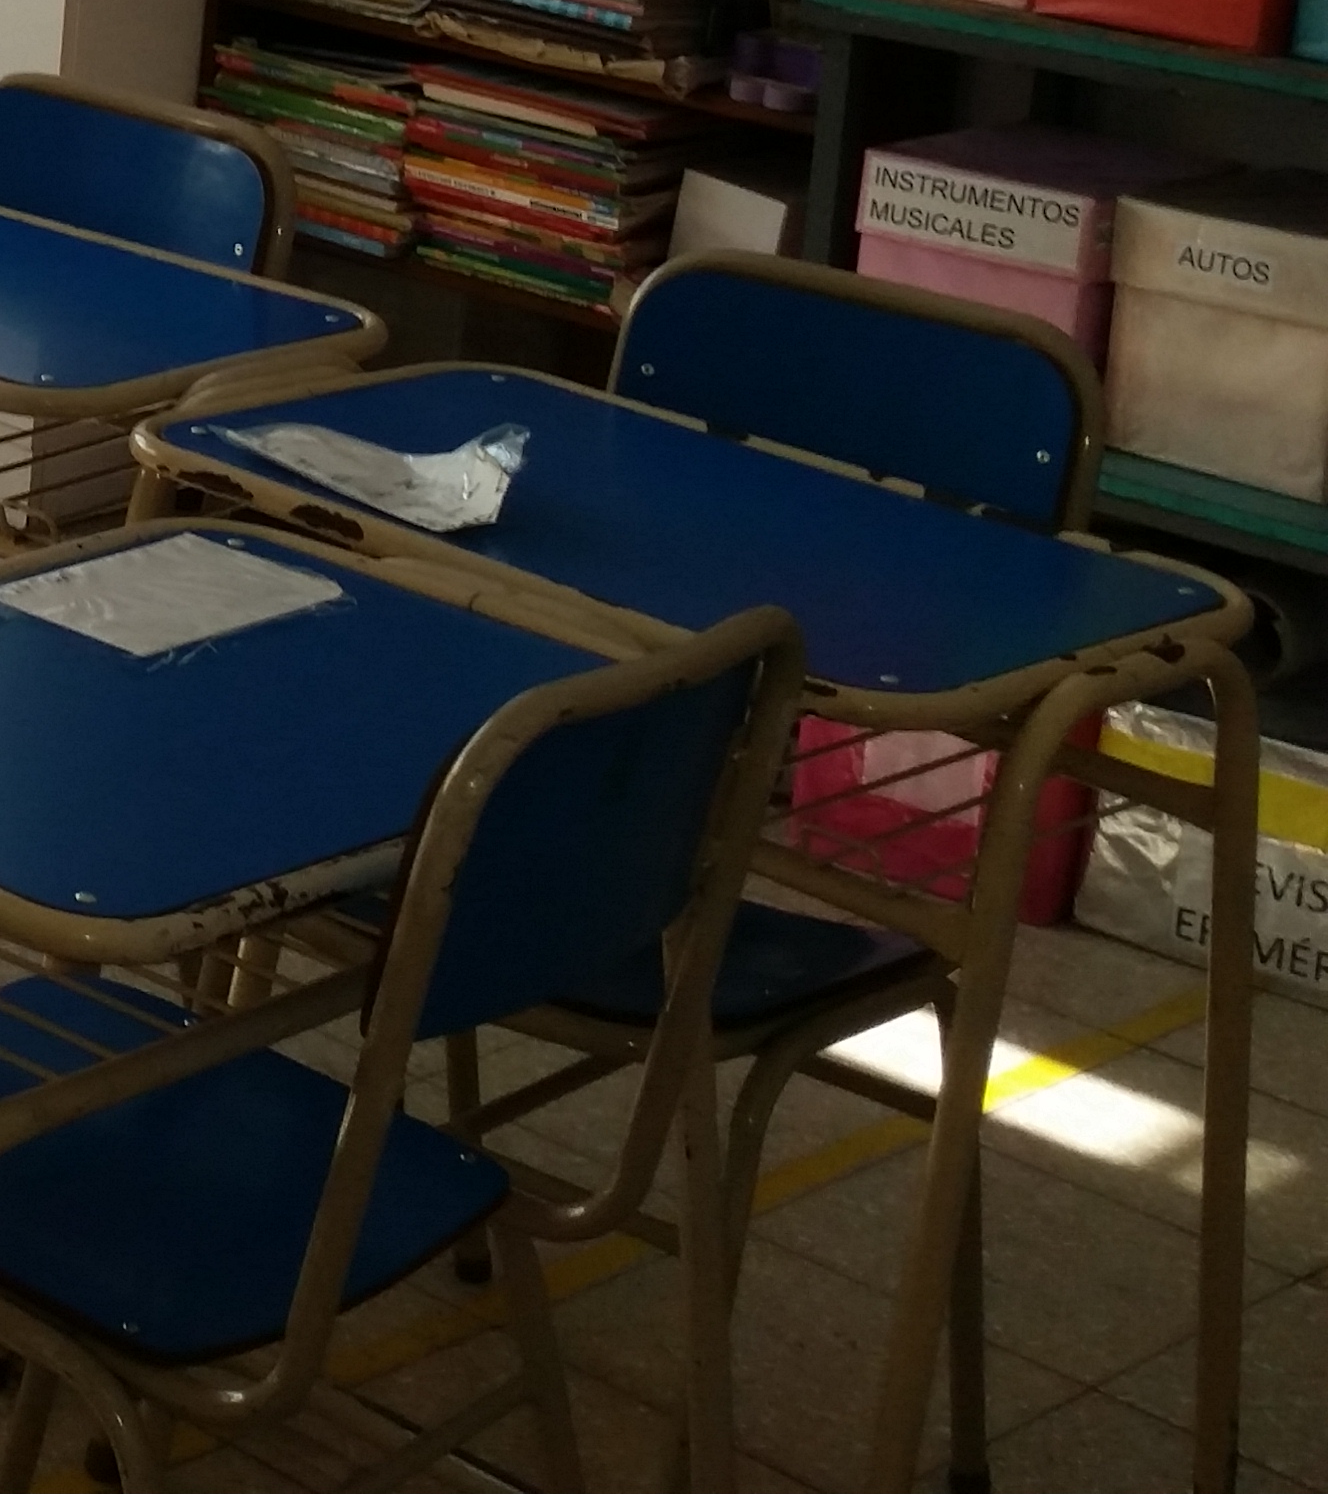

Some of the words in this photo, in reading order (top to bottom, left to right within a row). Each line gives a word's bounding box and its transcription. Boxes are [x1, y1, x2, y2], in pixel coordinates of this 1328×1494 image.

[869, 197, 1016, 250] MUSICALES
[875, 166, 1080, 228] INSTRUMENTOS
[1178, 245, 1271, 284] AUTOS
